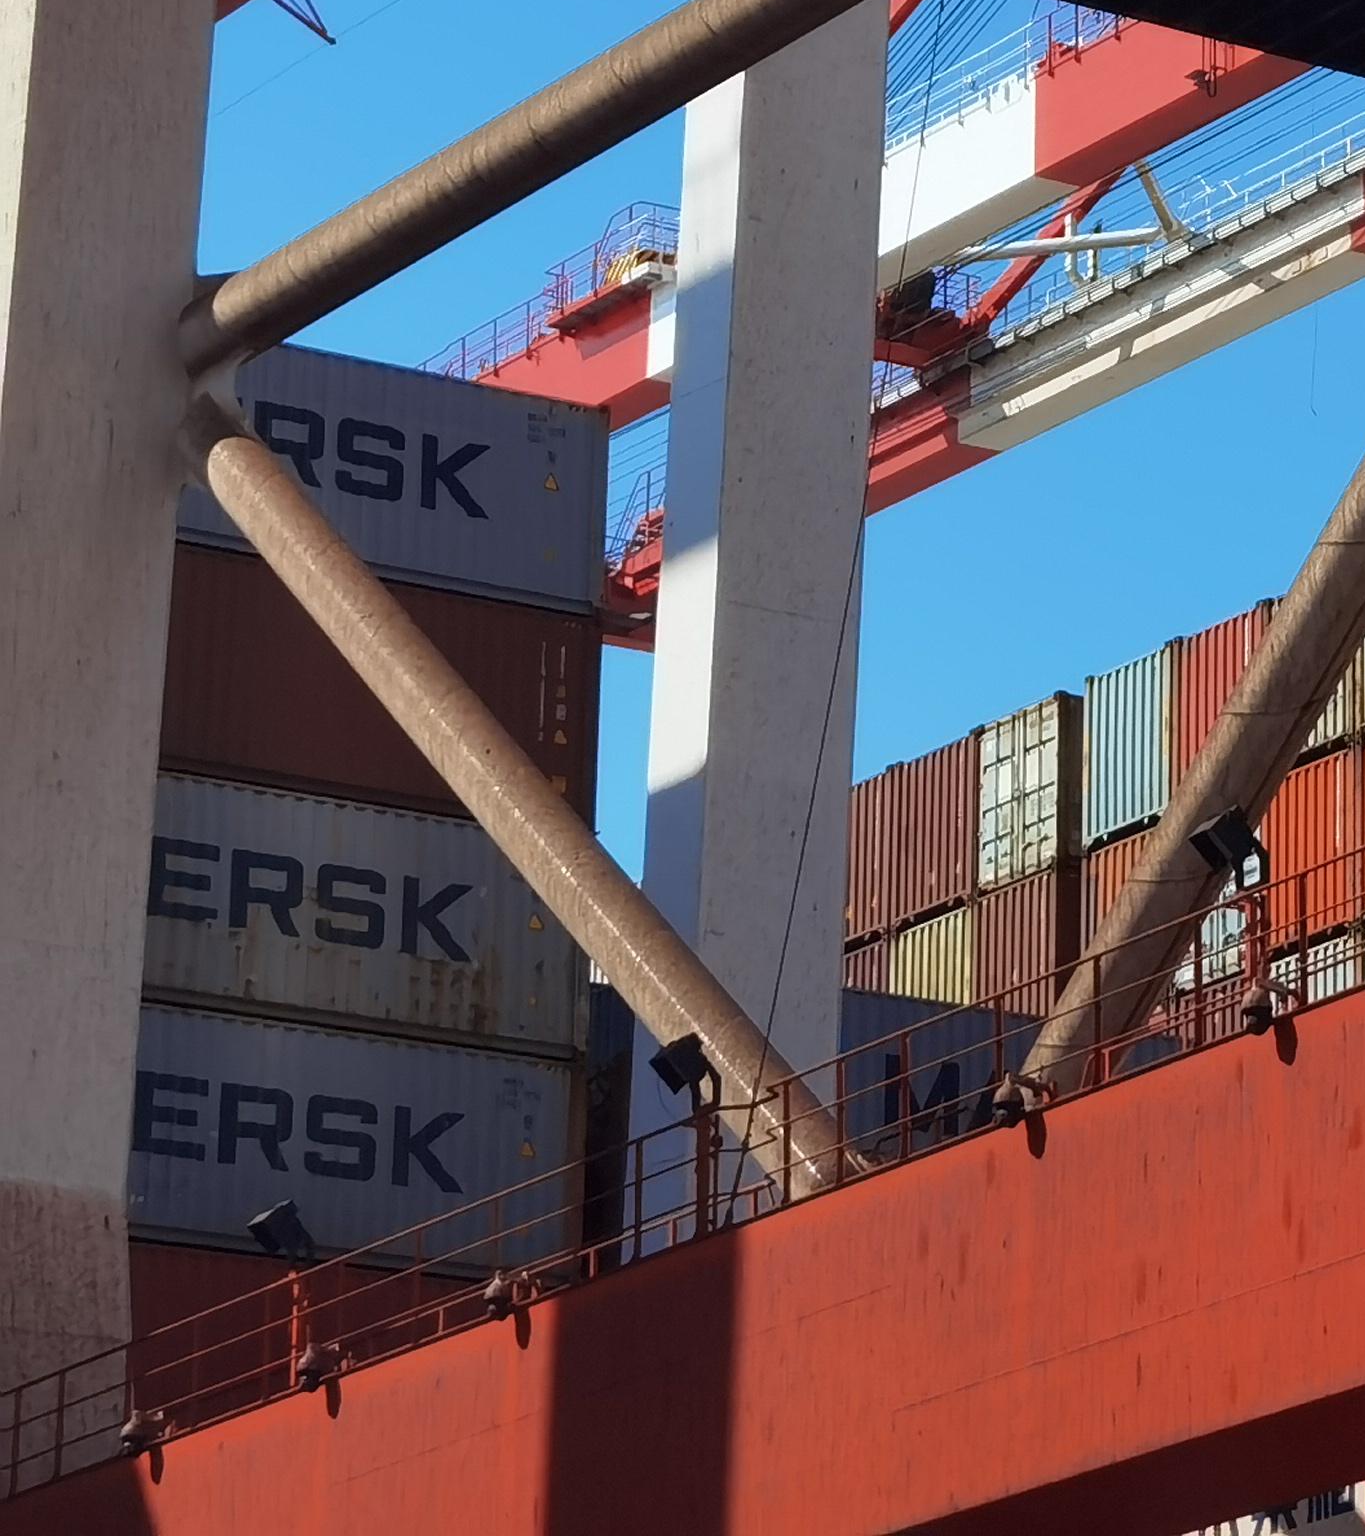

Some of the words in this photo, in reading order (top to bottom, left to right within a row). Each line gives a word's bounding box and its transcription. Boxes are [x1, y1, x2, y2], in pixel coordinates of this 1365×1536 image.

[237, 396, 492, 520] RSK
[146, 835, 474, 962] ERSK
[131, 1069, 467, 1195] ERSK
